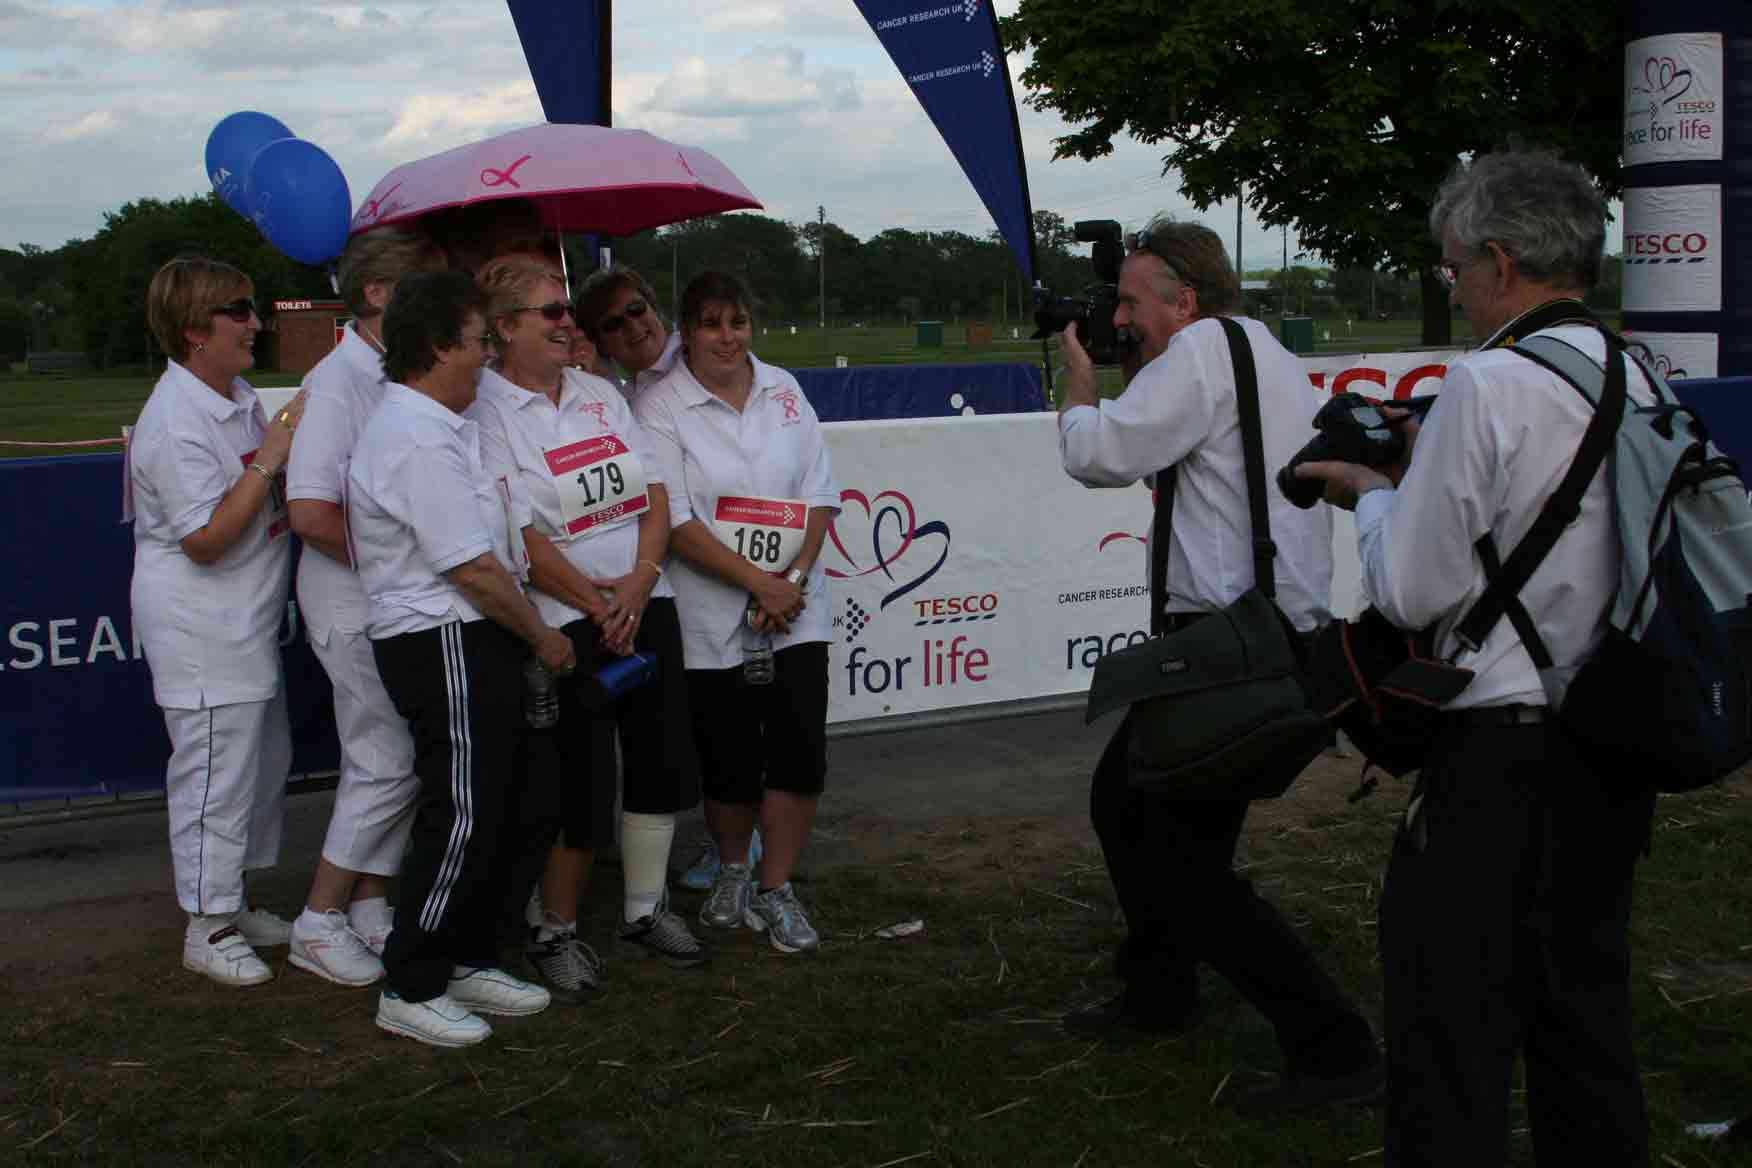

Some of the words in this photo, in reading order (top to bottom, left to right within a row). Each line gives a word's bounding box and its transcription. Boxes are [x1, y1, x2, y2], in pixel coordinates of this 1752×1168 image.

[877, 17, 908, 30] CANCER
[910, 8, 950, 23] RESEARCH
[952, 3, 964, 13] UK
[936, 64, 971, 78] RESEARCH
[1650, 121, 1674, 142] for
[1680, 119, 1712, 140] life
[1625, 233, 1706, 254] TESCO
[275, 301, 313, 310] TOILETS
[577, 462, 625, 507] 179
[590, 504, 624, 524] TESCO
[735, 528, 781, 563] 168
[914, 593, 998, 617] TESCO
[1058, 591, 1097, 604] CANCER
[1099, 585, 1150, 600] RESEARCH
[0, 616, 146, 670] SEA
[845, 647, 912, 696] for
[923, 635, 990, 687] life
